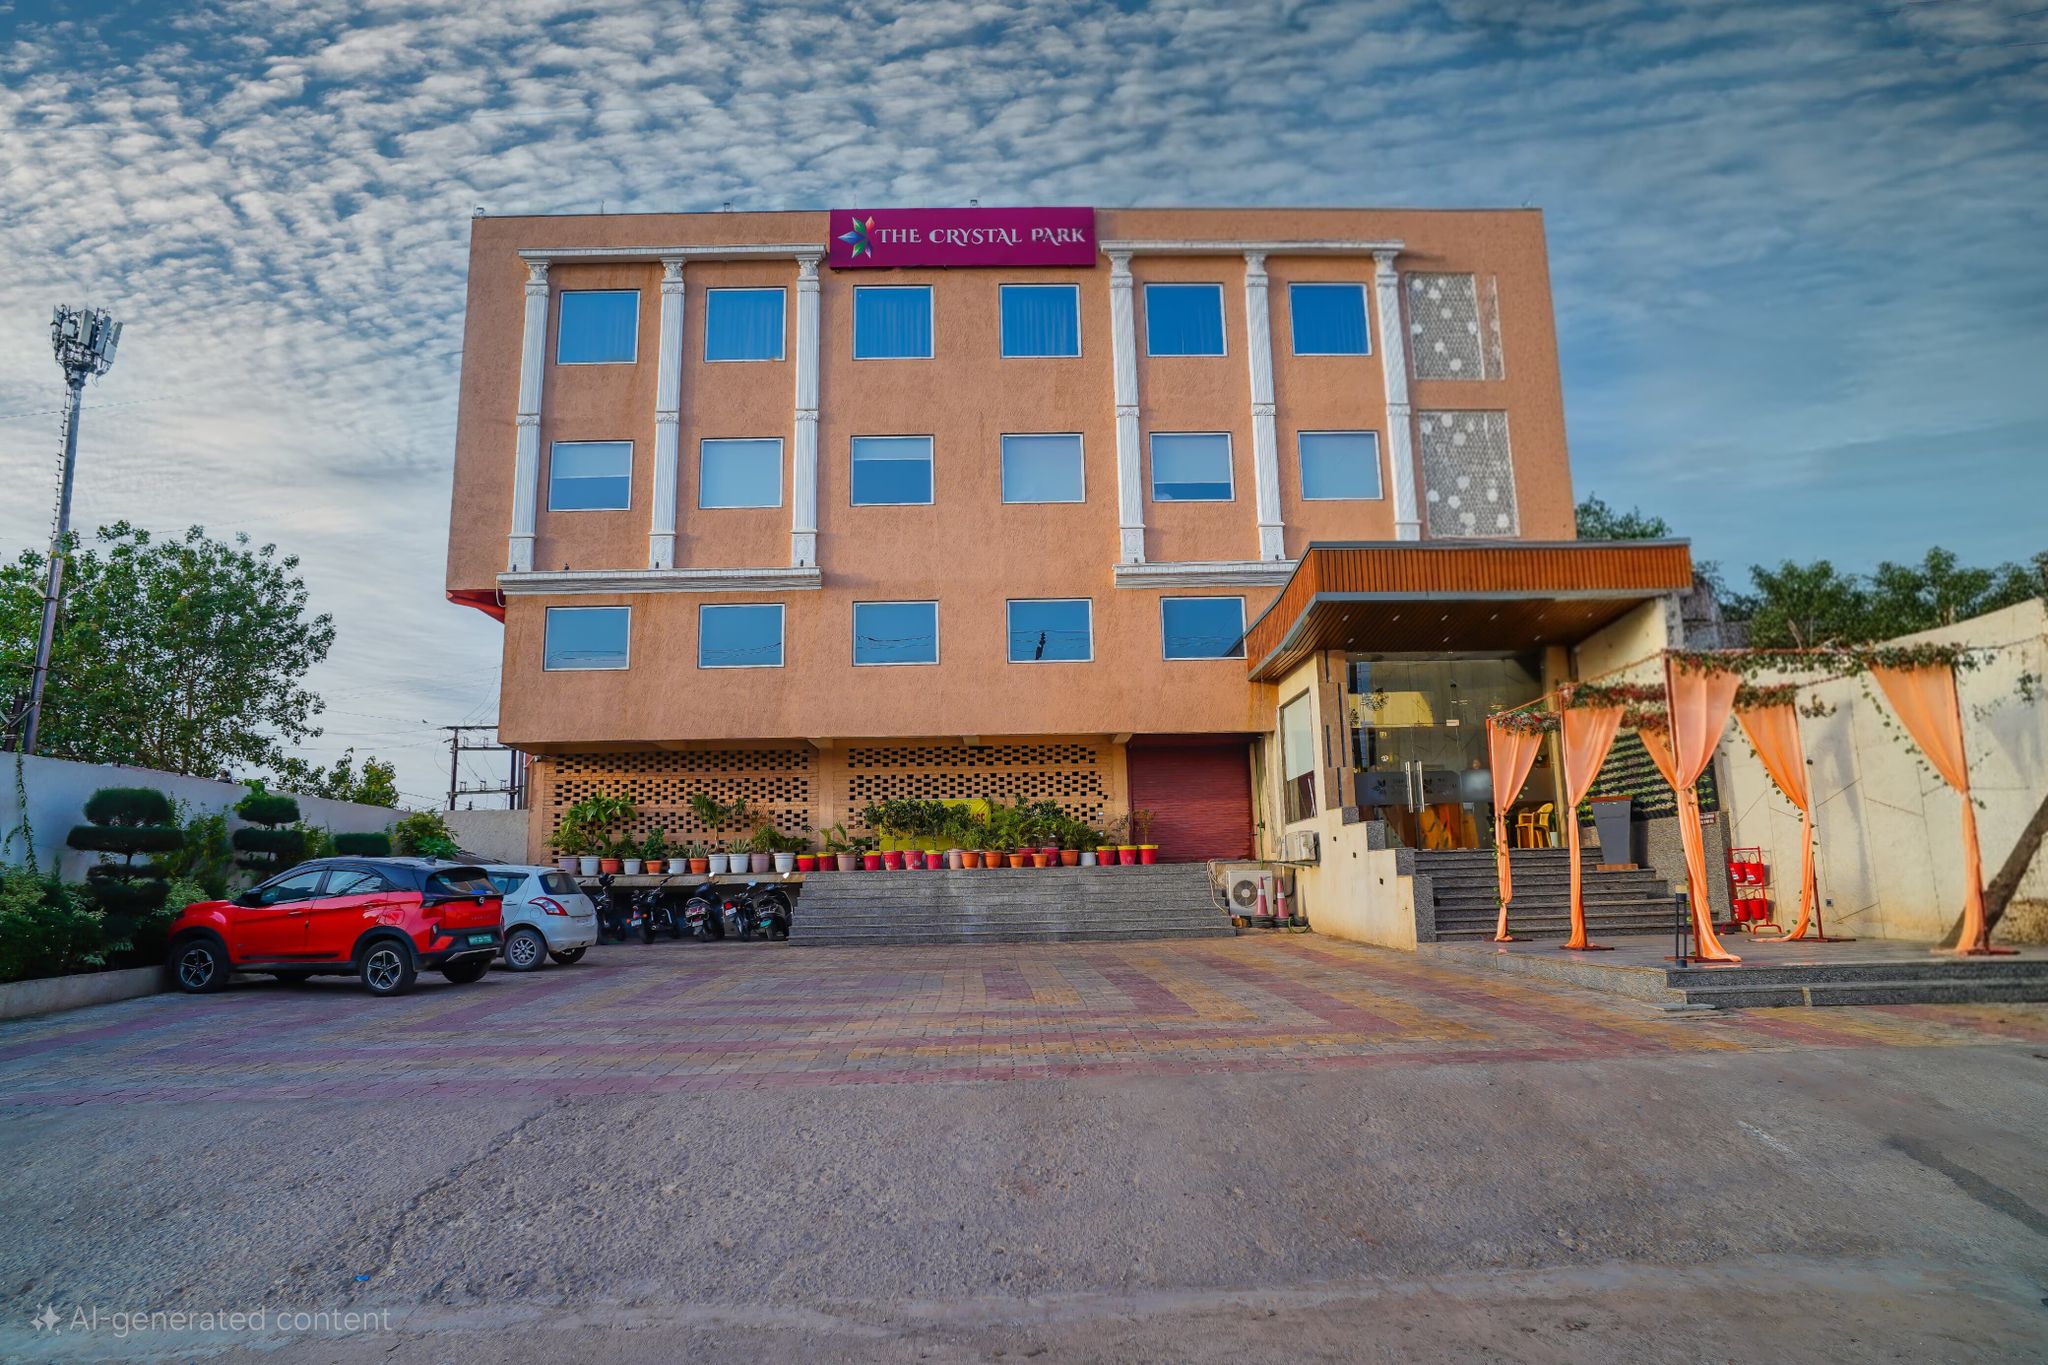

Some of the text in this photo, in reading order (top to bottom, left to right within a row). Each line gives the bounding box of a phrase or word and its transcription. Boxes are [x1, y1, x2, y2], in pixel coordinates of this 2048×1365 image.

[875, 227, 1086, 247] THE CRYSTAL PARK
